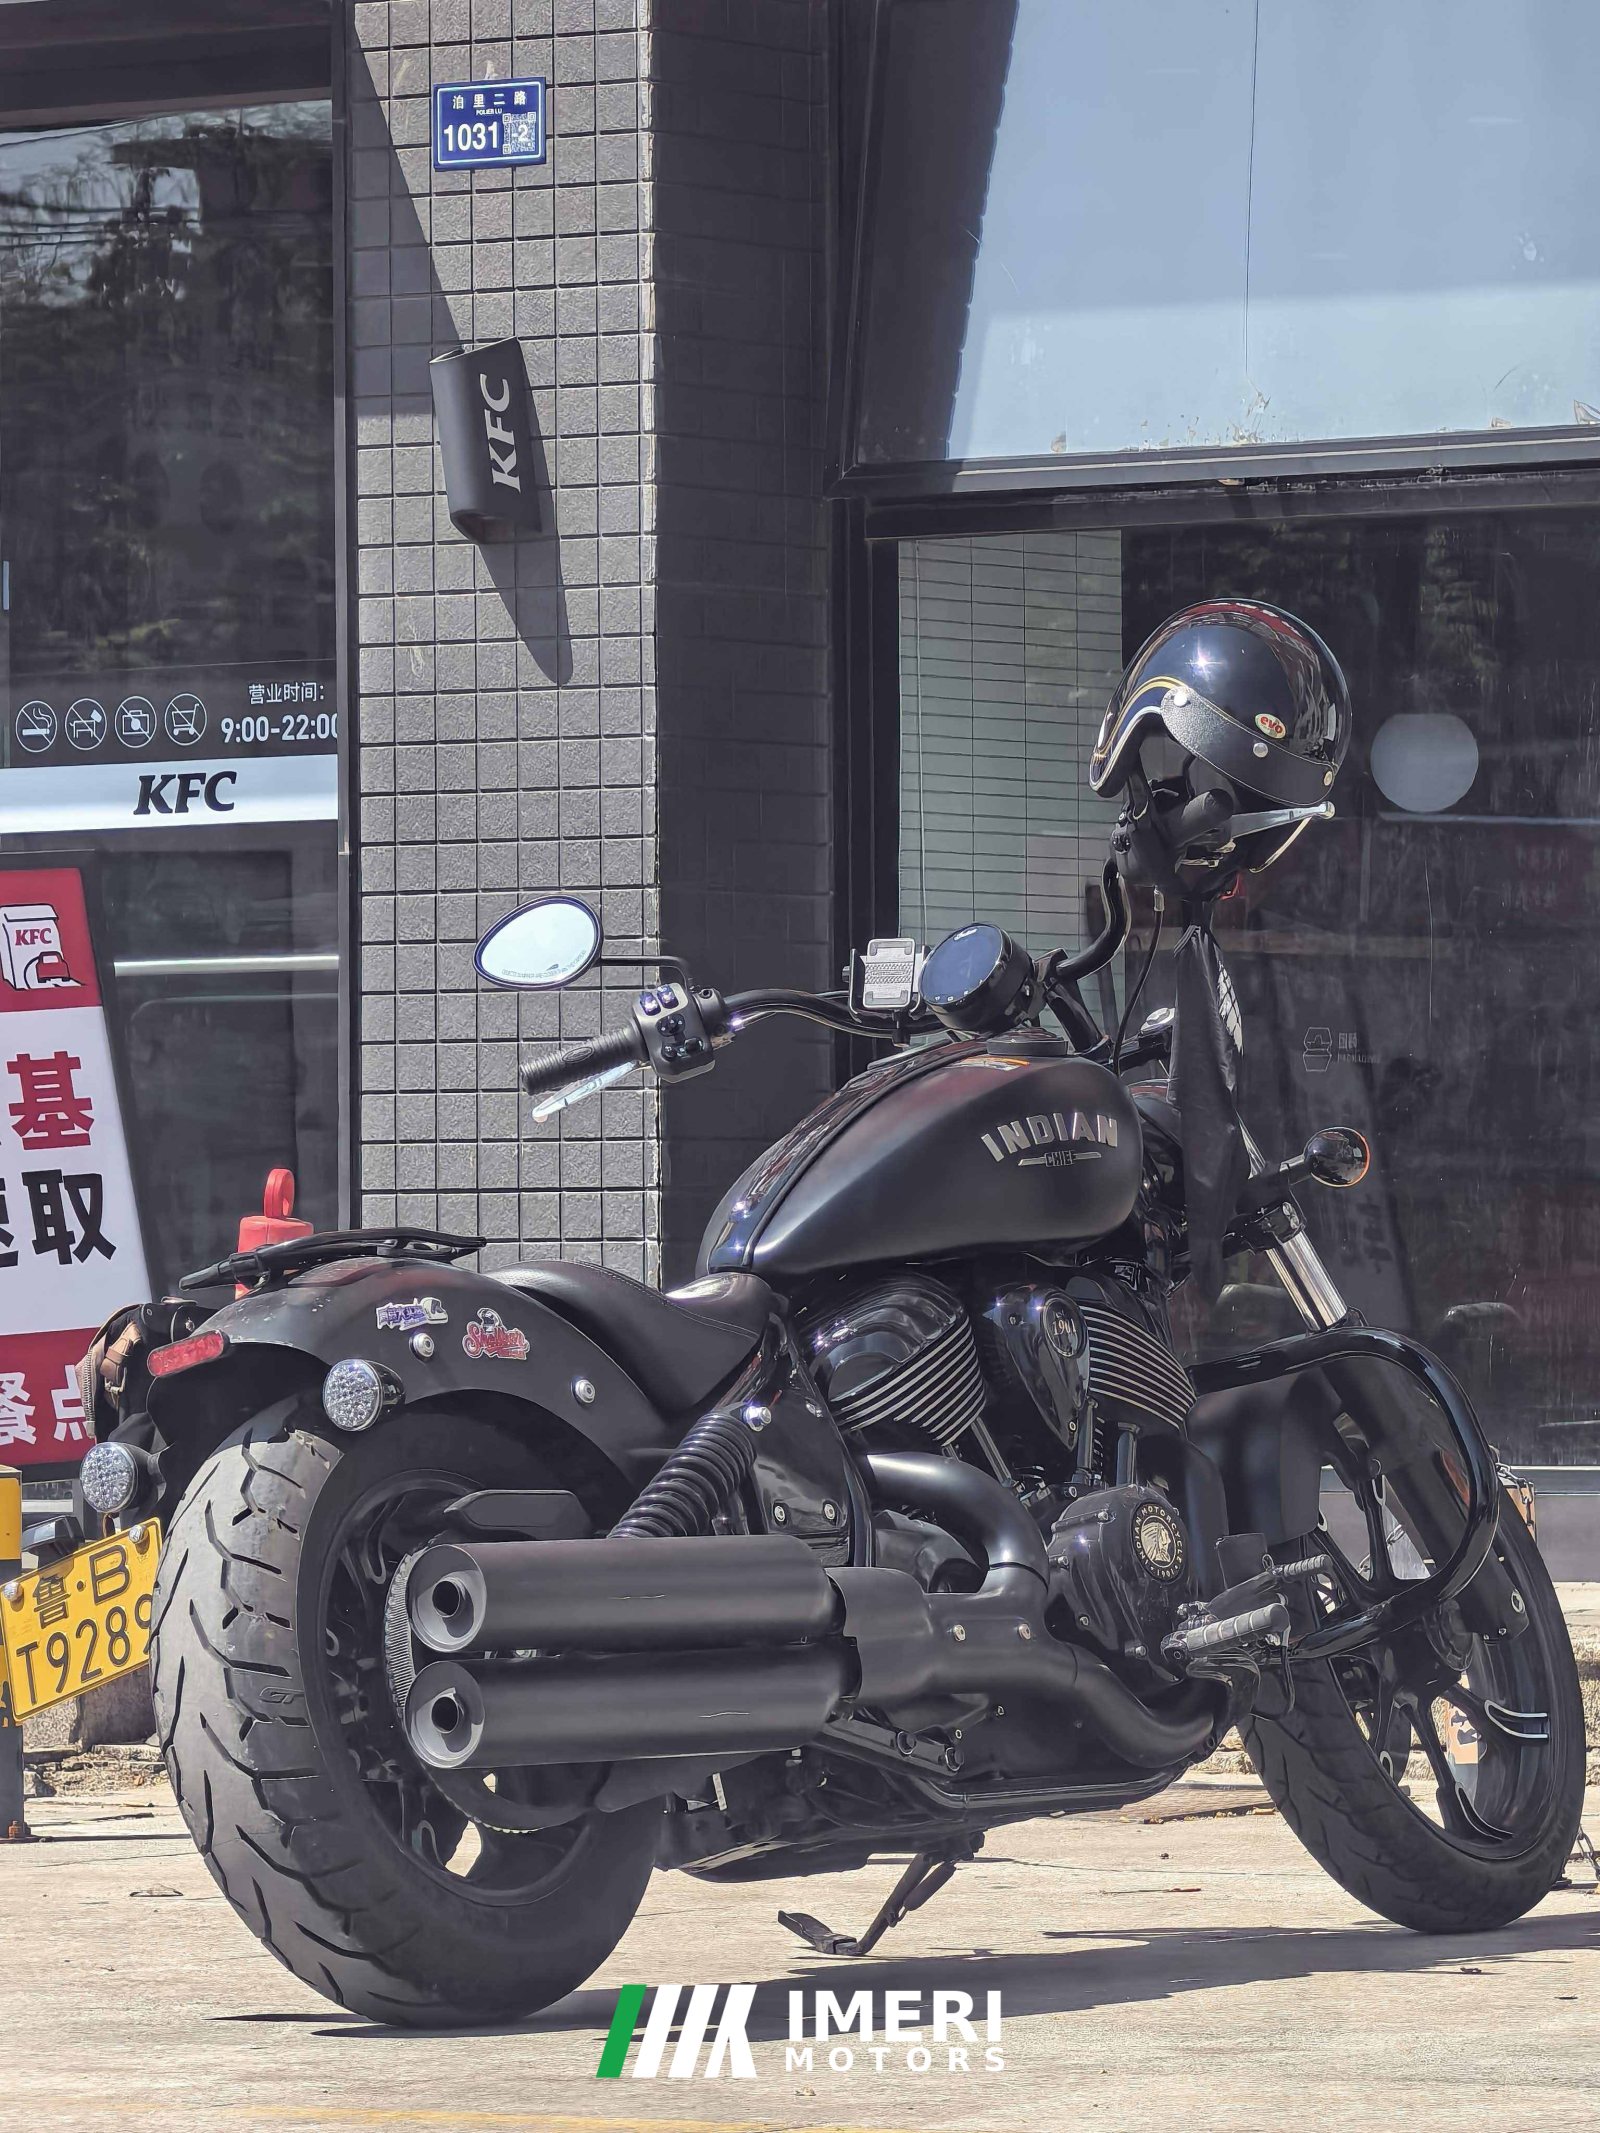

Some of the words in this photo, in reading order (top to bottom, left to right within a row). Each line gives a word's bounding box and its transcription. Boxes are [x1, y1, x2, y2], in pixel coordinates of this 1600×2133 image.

[452, 90, 527, 109] 泊里二路
[443, 121, 498, 152] 1031
[480, 373, 522, 494] KFC
[1260, 716, 1284, 734] evo
[133, 770, 238, 816] KFC
[14, 927, 53, 947] KFC
[980, 1111, 1118, 1162] INDIAN
[0, 1168, 117, 1268] 取
[1052, 1317, 1077, 1336] 1901
[1134, 1516, 1149, 1565] INDIAN
[1141, 1505, 1183, 1563] MOTORCYCLE
